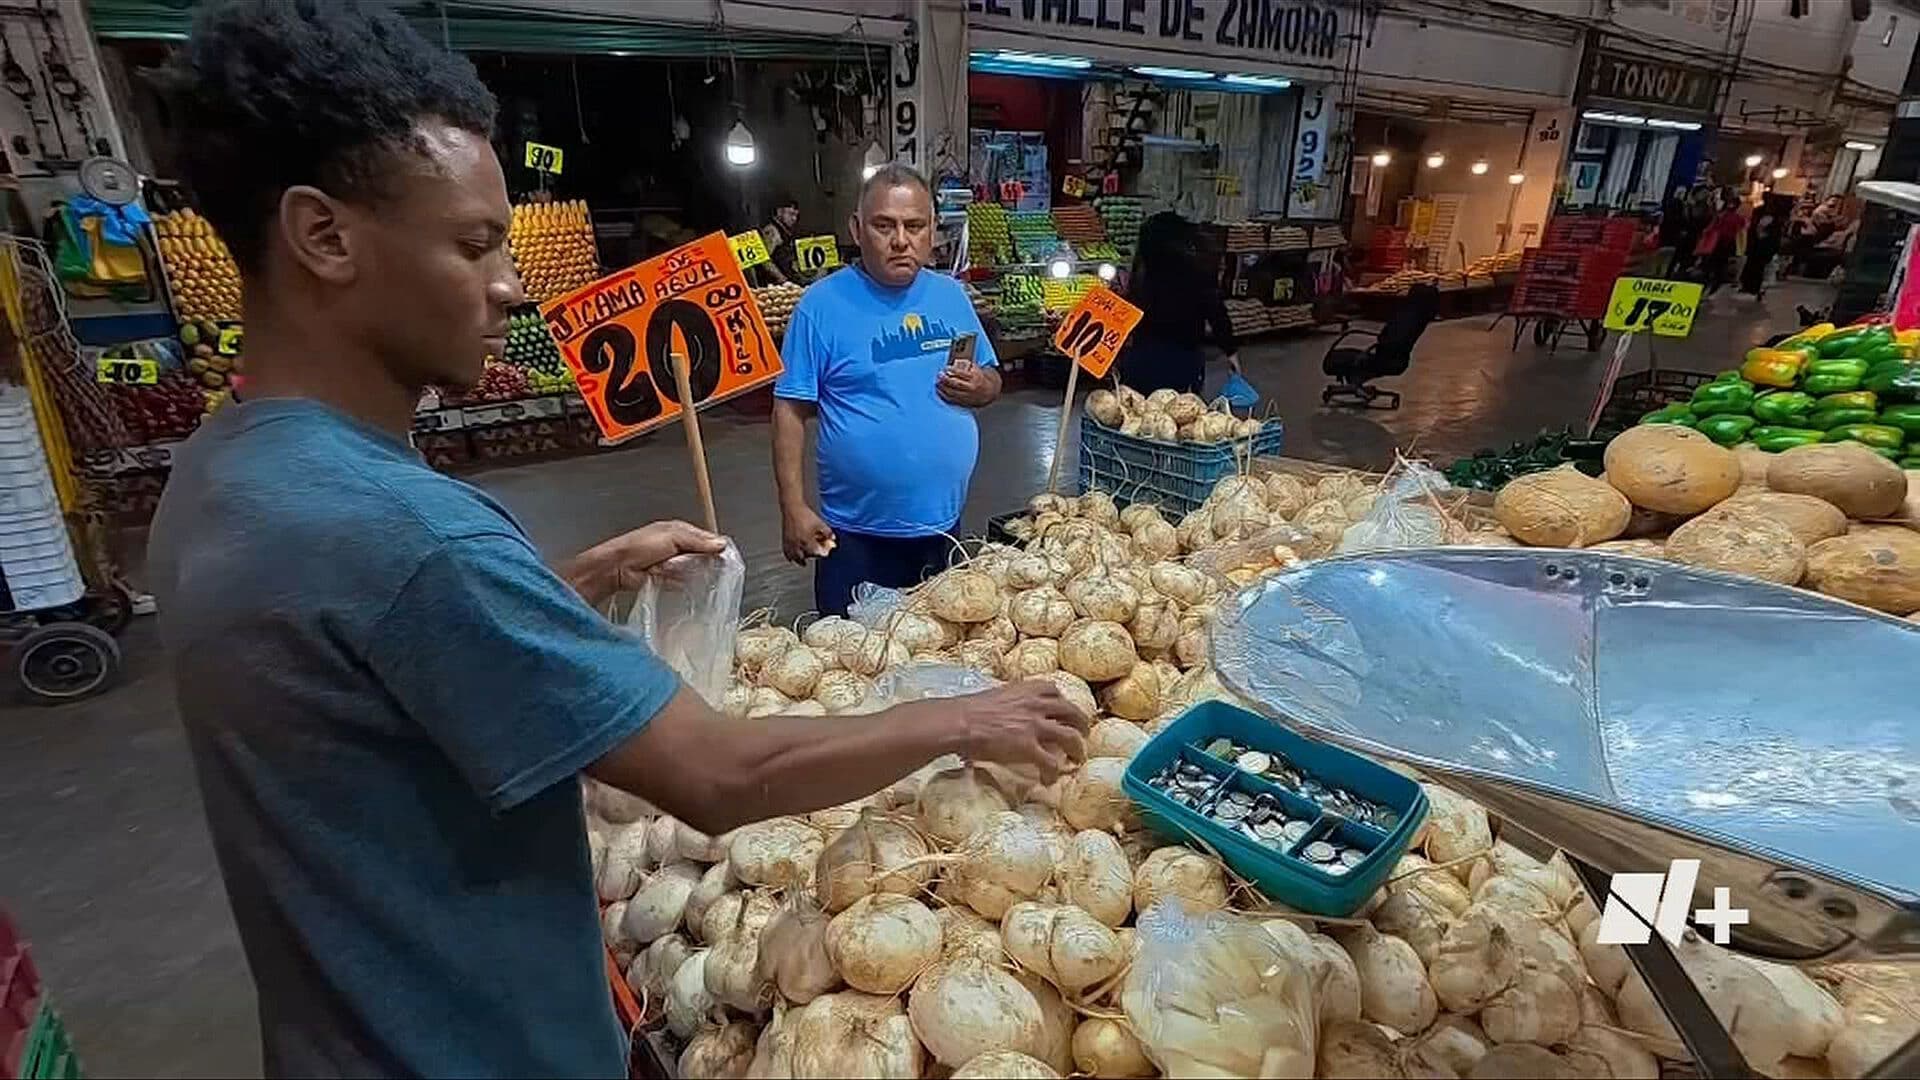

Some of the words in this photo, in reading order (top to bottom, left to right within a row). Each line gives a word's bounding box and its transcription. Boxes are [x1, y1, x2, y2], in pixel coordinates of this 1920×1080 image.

[1159, 0, 1204, 41] DE
[1215, 0, 1338, 59] ZAMORA
[804, 246, 825, 268] 10
[549, 279, 645, 341] JICAMA
[1060, 310, 1105, 358] 10
[580, 298, 720, 426] 20
[705, 283, 742, 308] 00
